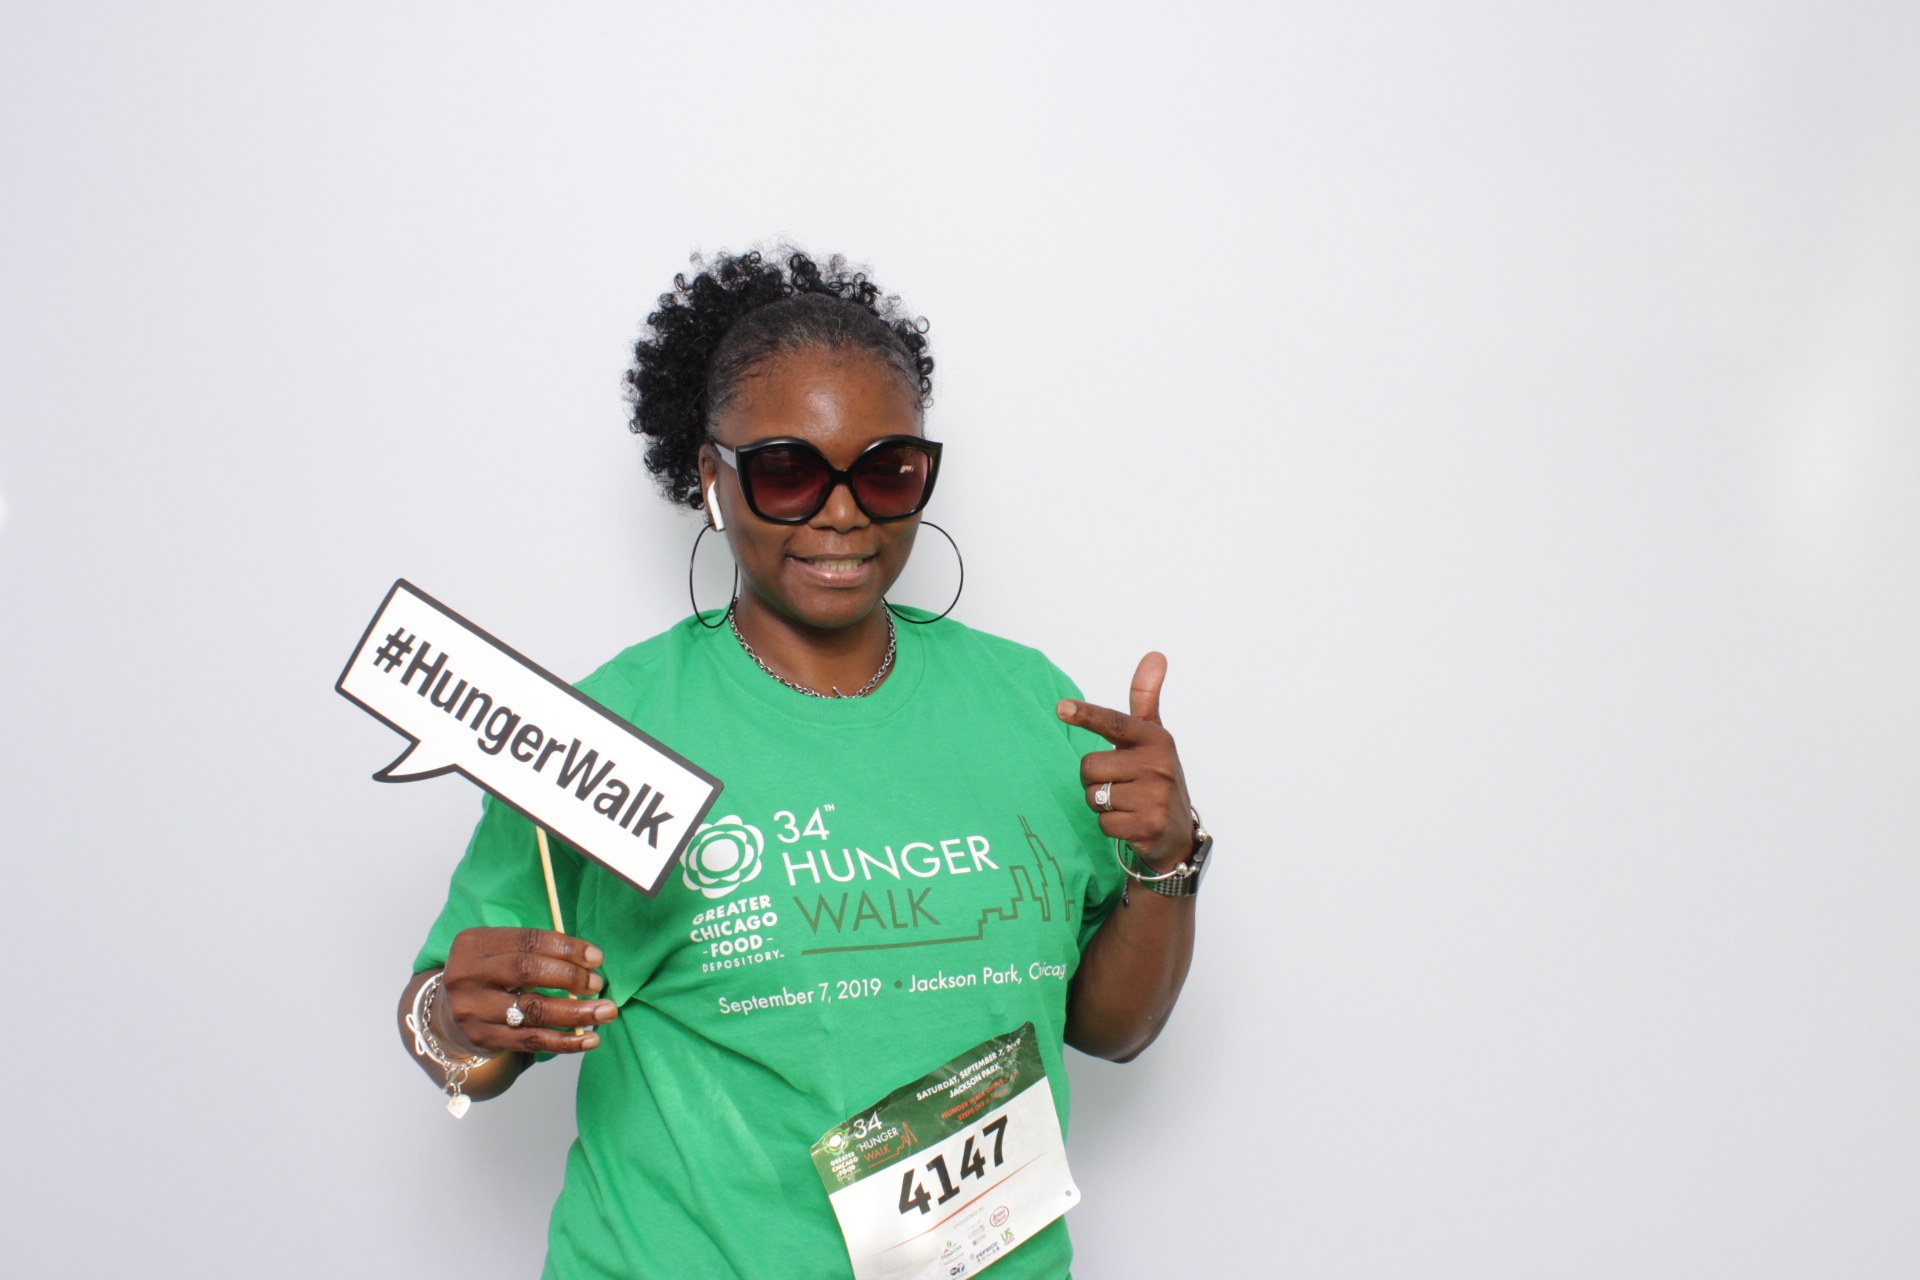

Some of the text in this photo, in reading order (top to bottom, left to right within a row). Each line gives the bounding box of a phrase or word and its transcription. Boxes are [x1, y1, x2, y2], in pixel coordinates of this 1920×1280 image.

[373, 627, 675, 849] #HungerWalk
[782, 836, 999, 886] HUNGER
[692, 895, 772, 925] GREATER
[793, 887, 941, 935] WALK
[690, 912, 778, 942] CHICAGO
[702, 950, 780, 973] DEPOSITORY
[909, 971, 976, 992] Jackson
[983, 964, 1022, 984] Park,
[719, 978, 881, 1015] September 7, 2019
[916, 1075, 960, 1101] SATURDAY,
[960, 1052, 997, 1079] SEPTEMBER
[949, 1073, 982, 1098] JACKSON
[981, 1062, 1003, 1079] PARK
[941, 1100, 970, 1119] HUNGER
[969, 1091, 986, 1105] WALK
[957, 1108, 975, 1121] STEPS
[975, 1100, 985, 1111] OFF
[859, 1127, 899, 1152] HUNGER
[864, 1144, 891, 1162] WALK
[830, 1151, 856, 1167] GREATER
[831, 1156, 859, 1173] CHICAGO
[899, 1114, 1008, 1215] 4147
[1001, 1227, 1013, 1242] US
